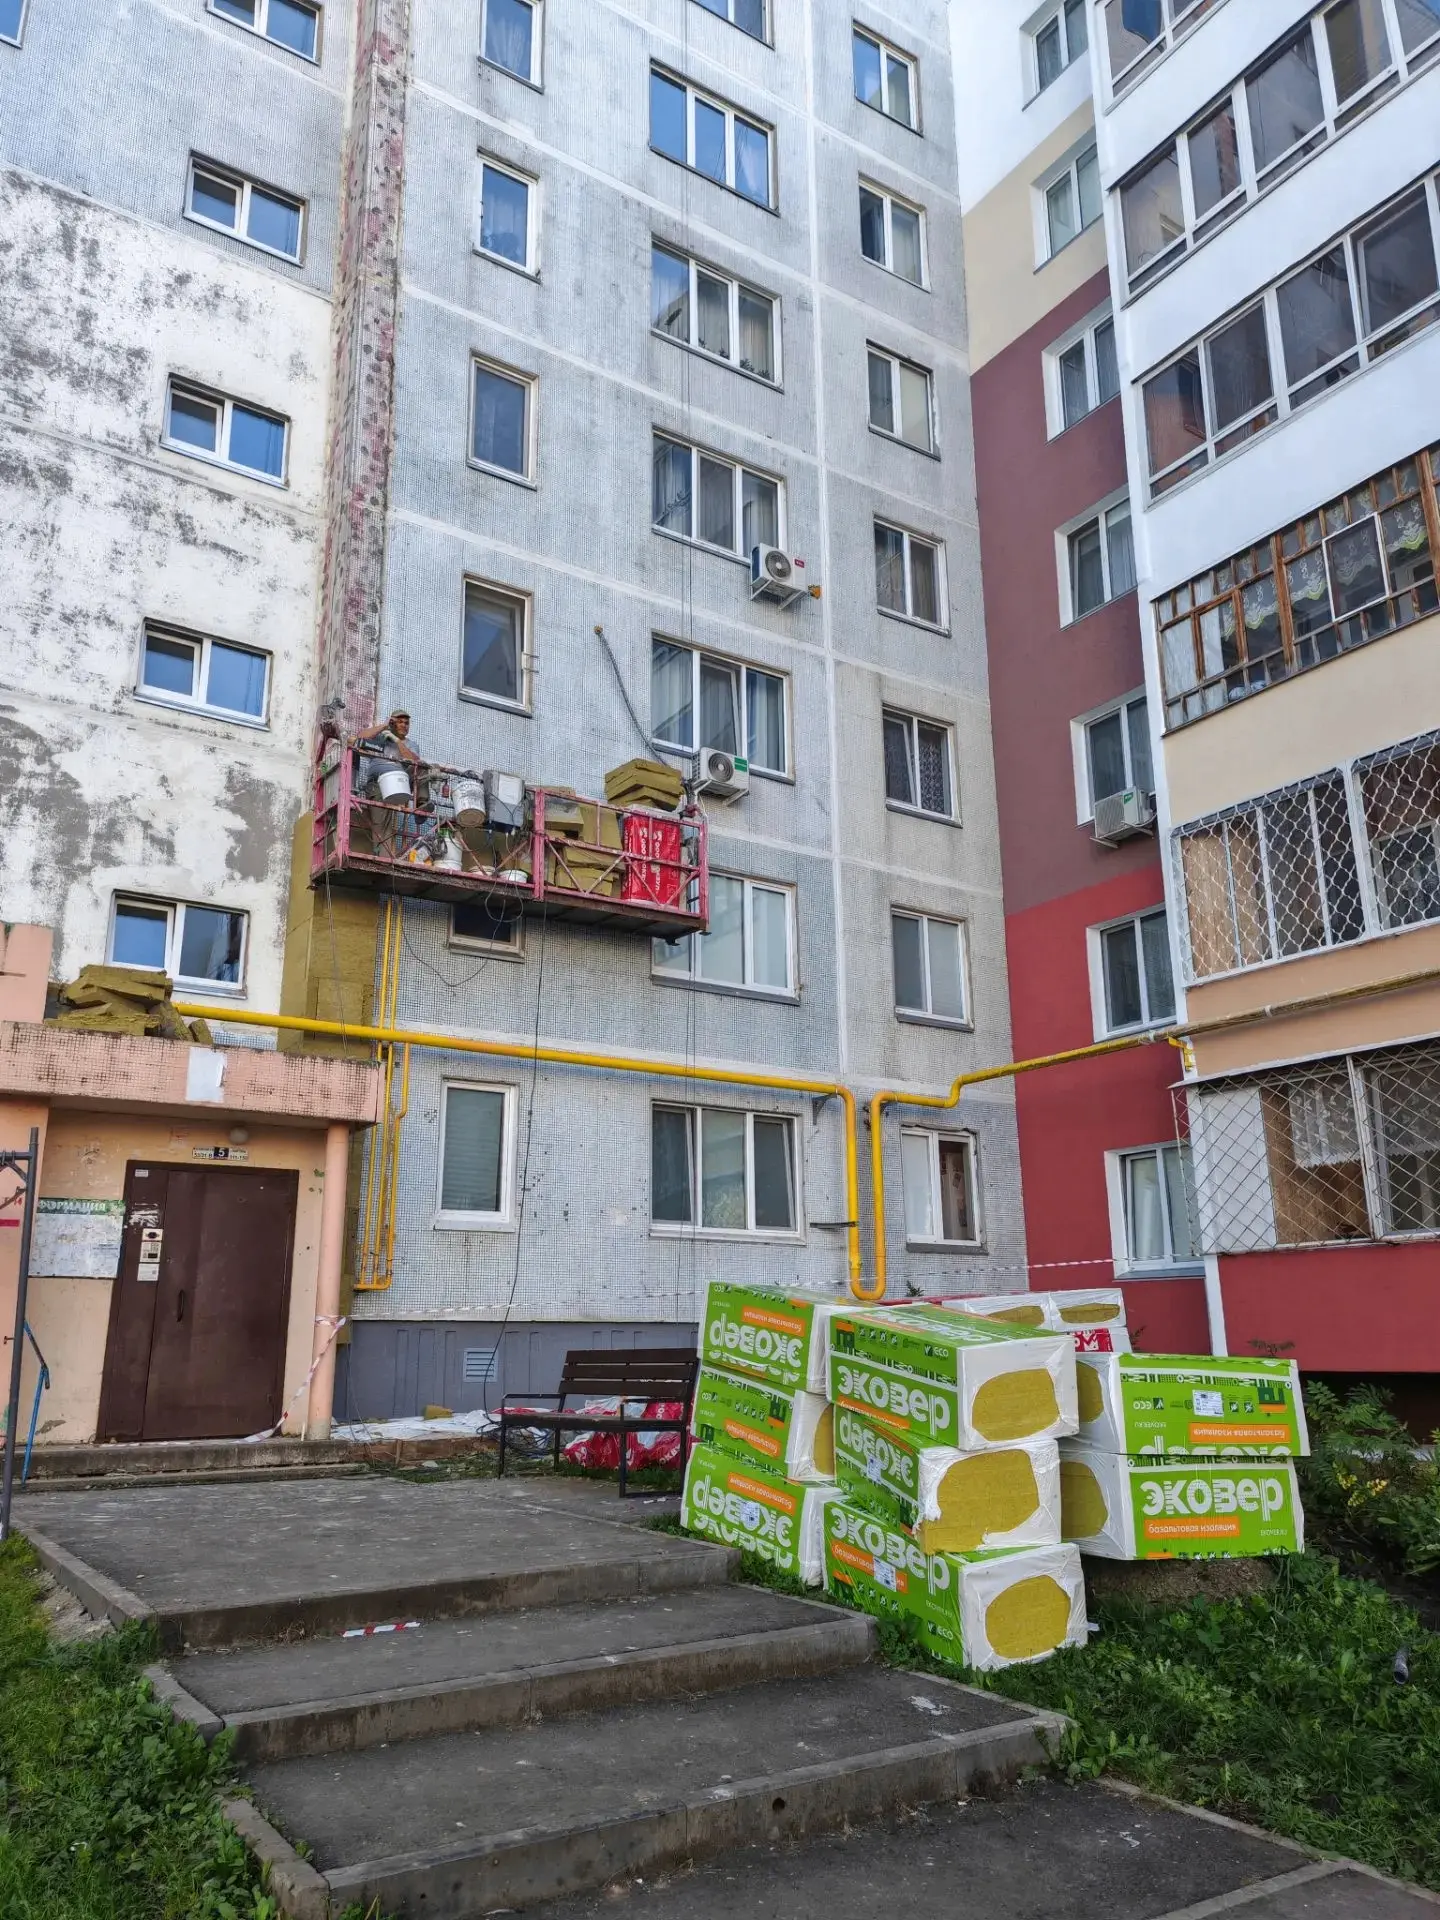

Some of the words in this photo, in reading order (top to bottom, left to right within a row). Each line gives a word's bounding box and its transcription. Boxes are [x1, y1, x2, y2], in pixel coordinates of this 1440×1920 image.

[39, 1200, 107, 1212] ФОРМАЦИЯ
[933, 1346, 950, 1358] ECO
[1148, 1523, 1200, 1535] базальтовая
[1200, 1523, 1237, 1534] изоляция
